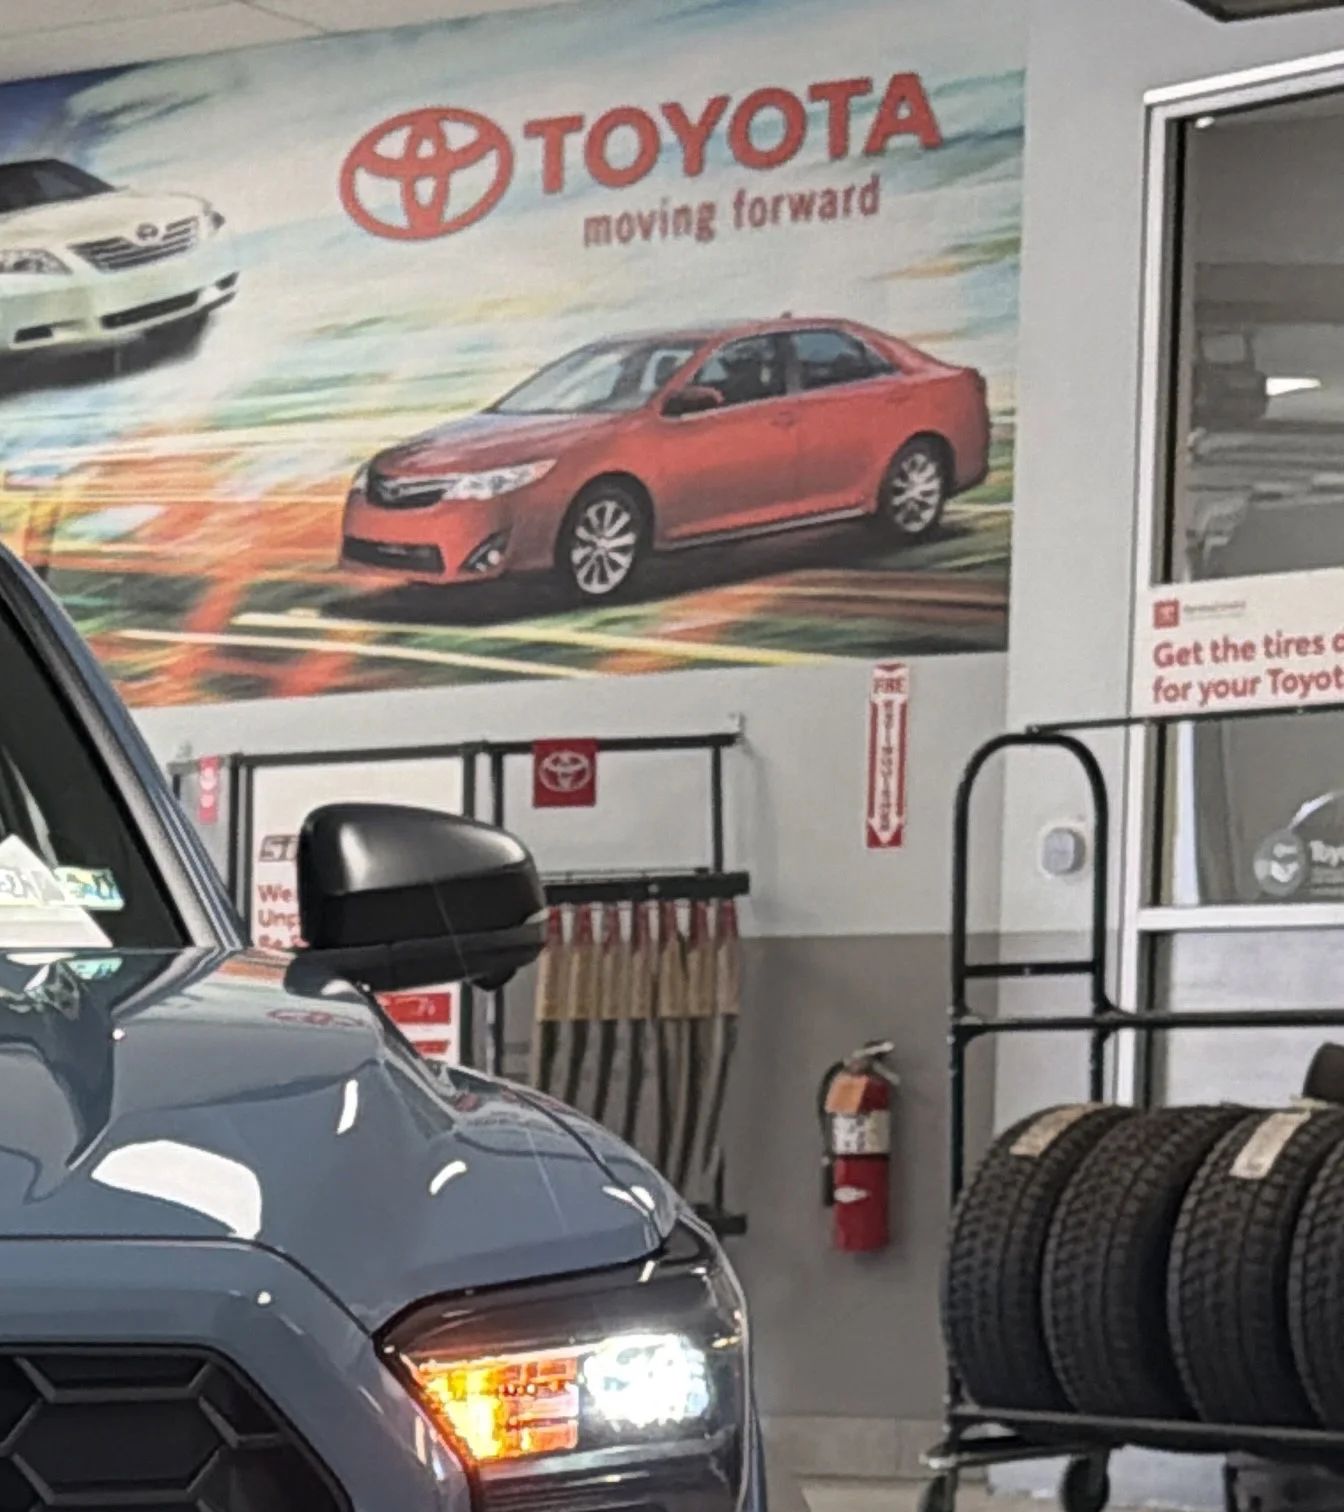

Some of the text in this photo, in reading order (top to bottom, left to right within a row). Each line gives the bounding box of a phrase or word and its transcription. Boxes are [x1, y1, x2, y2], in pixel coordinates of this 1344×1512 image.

[523, 72, 943, 194] TOYOTA
[584, 174, 881, 248] moving forward
[1153, 640, 1205, 669] Get
[1210, 634, 1257, 664] the
[1263, 629, 1326, 659] tires
[1153, 674, 1193, 704] for
[1198, 674, 1262, 707] your
